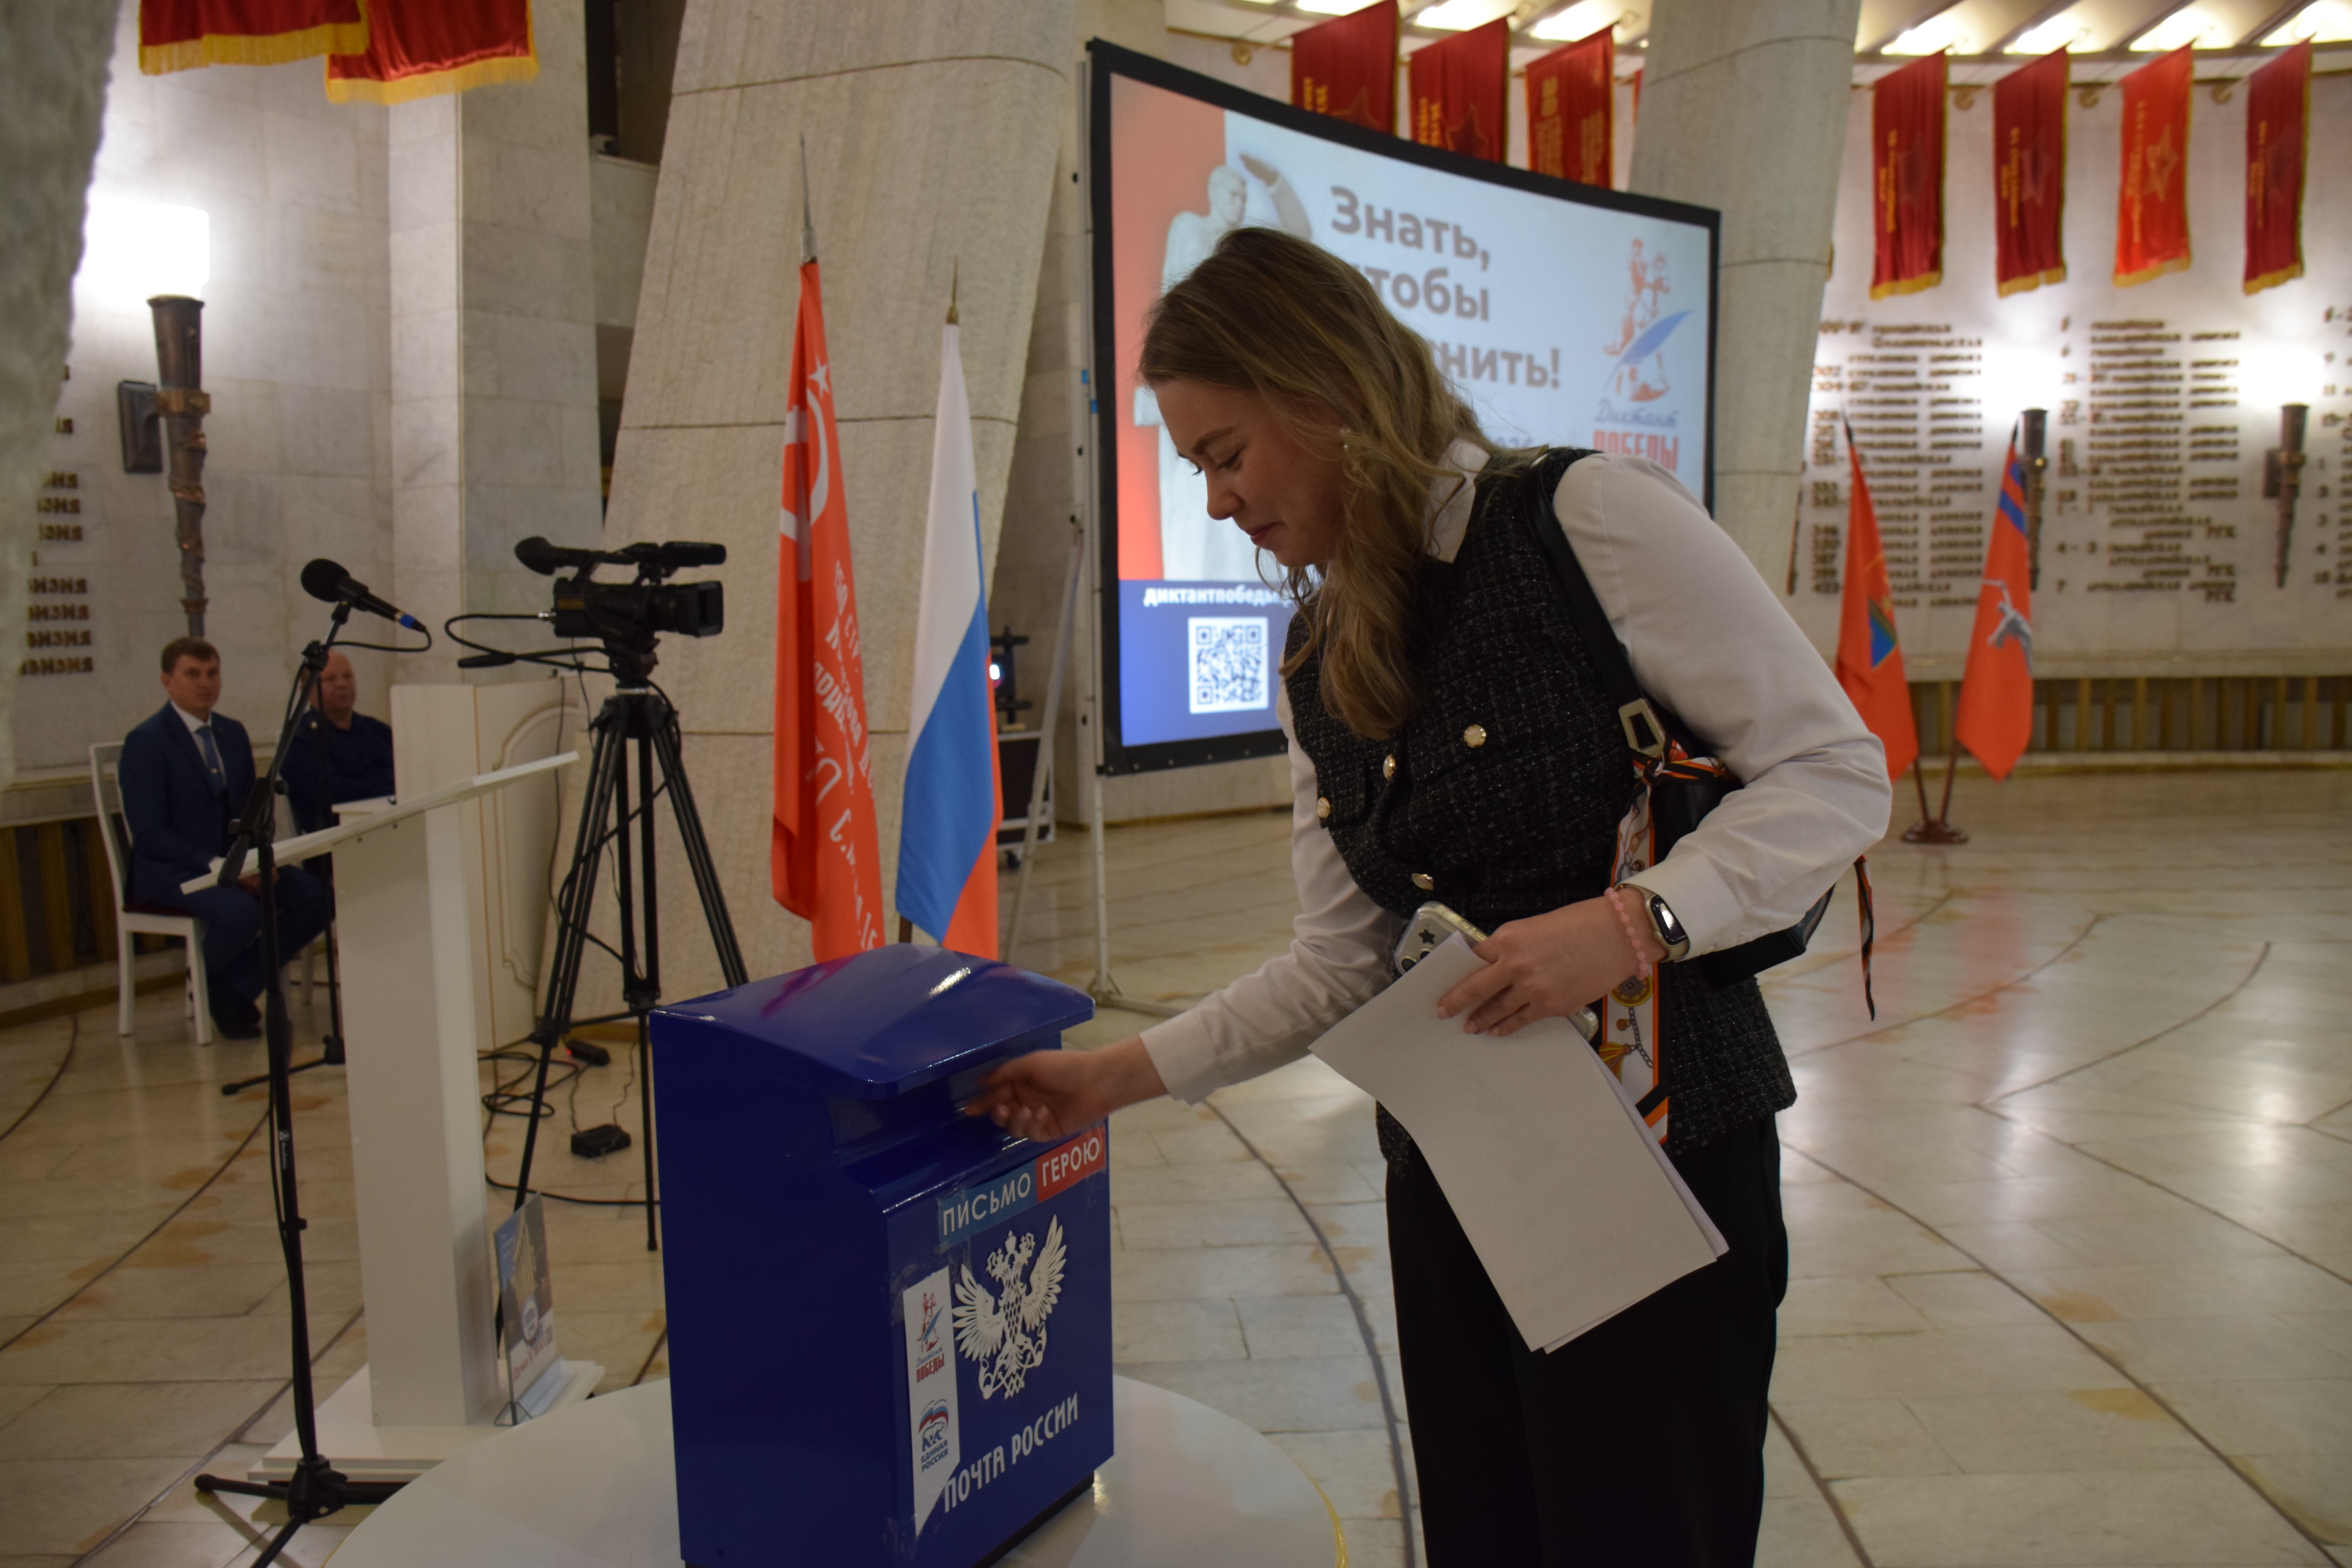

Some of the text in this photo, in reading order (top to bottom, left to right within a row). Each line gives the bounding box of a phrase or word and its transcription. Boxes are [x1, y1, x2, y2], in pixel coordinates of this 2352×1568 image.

[1330, 186, 1490, 271] Знать,
[1352, 264, 1489, 322] тобы
[943, 1137, 1100, 1236] ПИСЬМО ГЕРОЮ
[916, 1353, 945, 1384] ПОБЕДЫ
[921, 1439, 948, 1463] ЕДИНАЯ
[922, 1448, 948, 1473] РОССИЯ
[944, 1392, 1078, 1513] ПОЧТА РОССИИ
